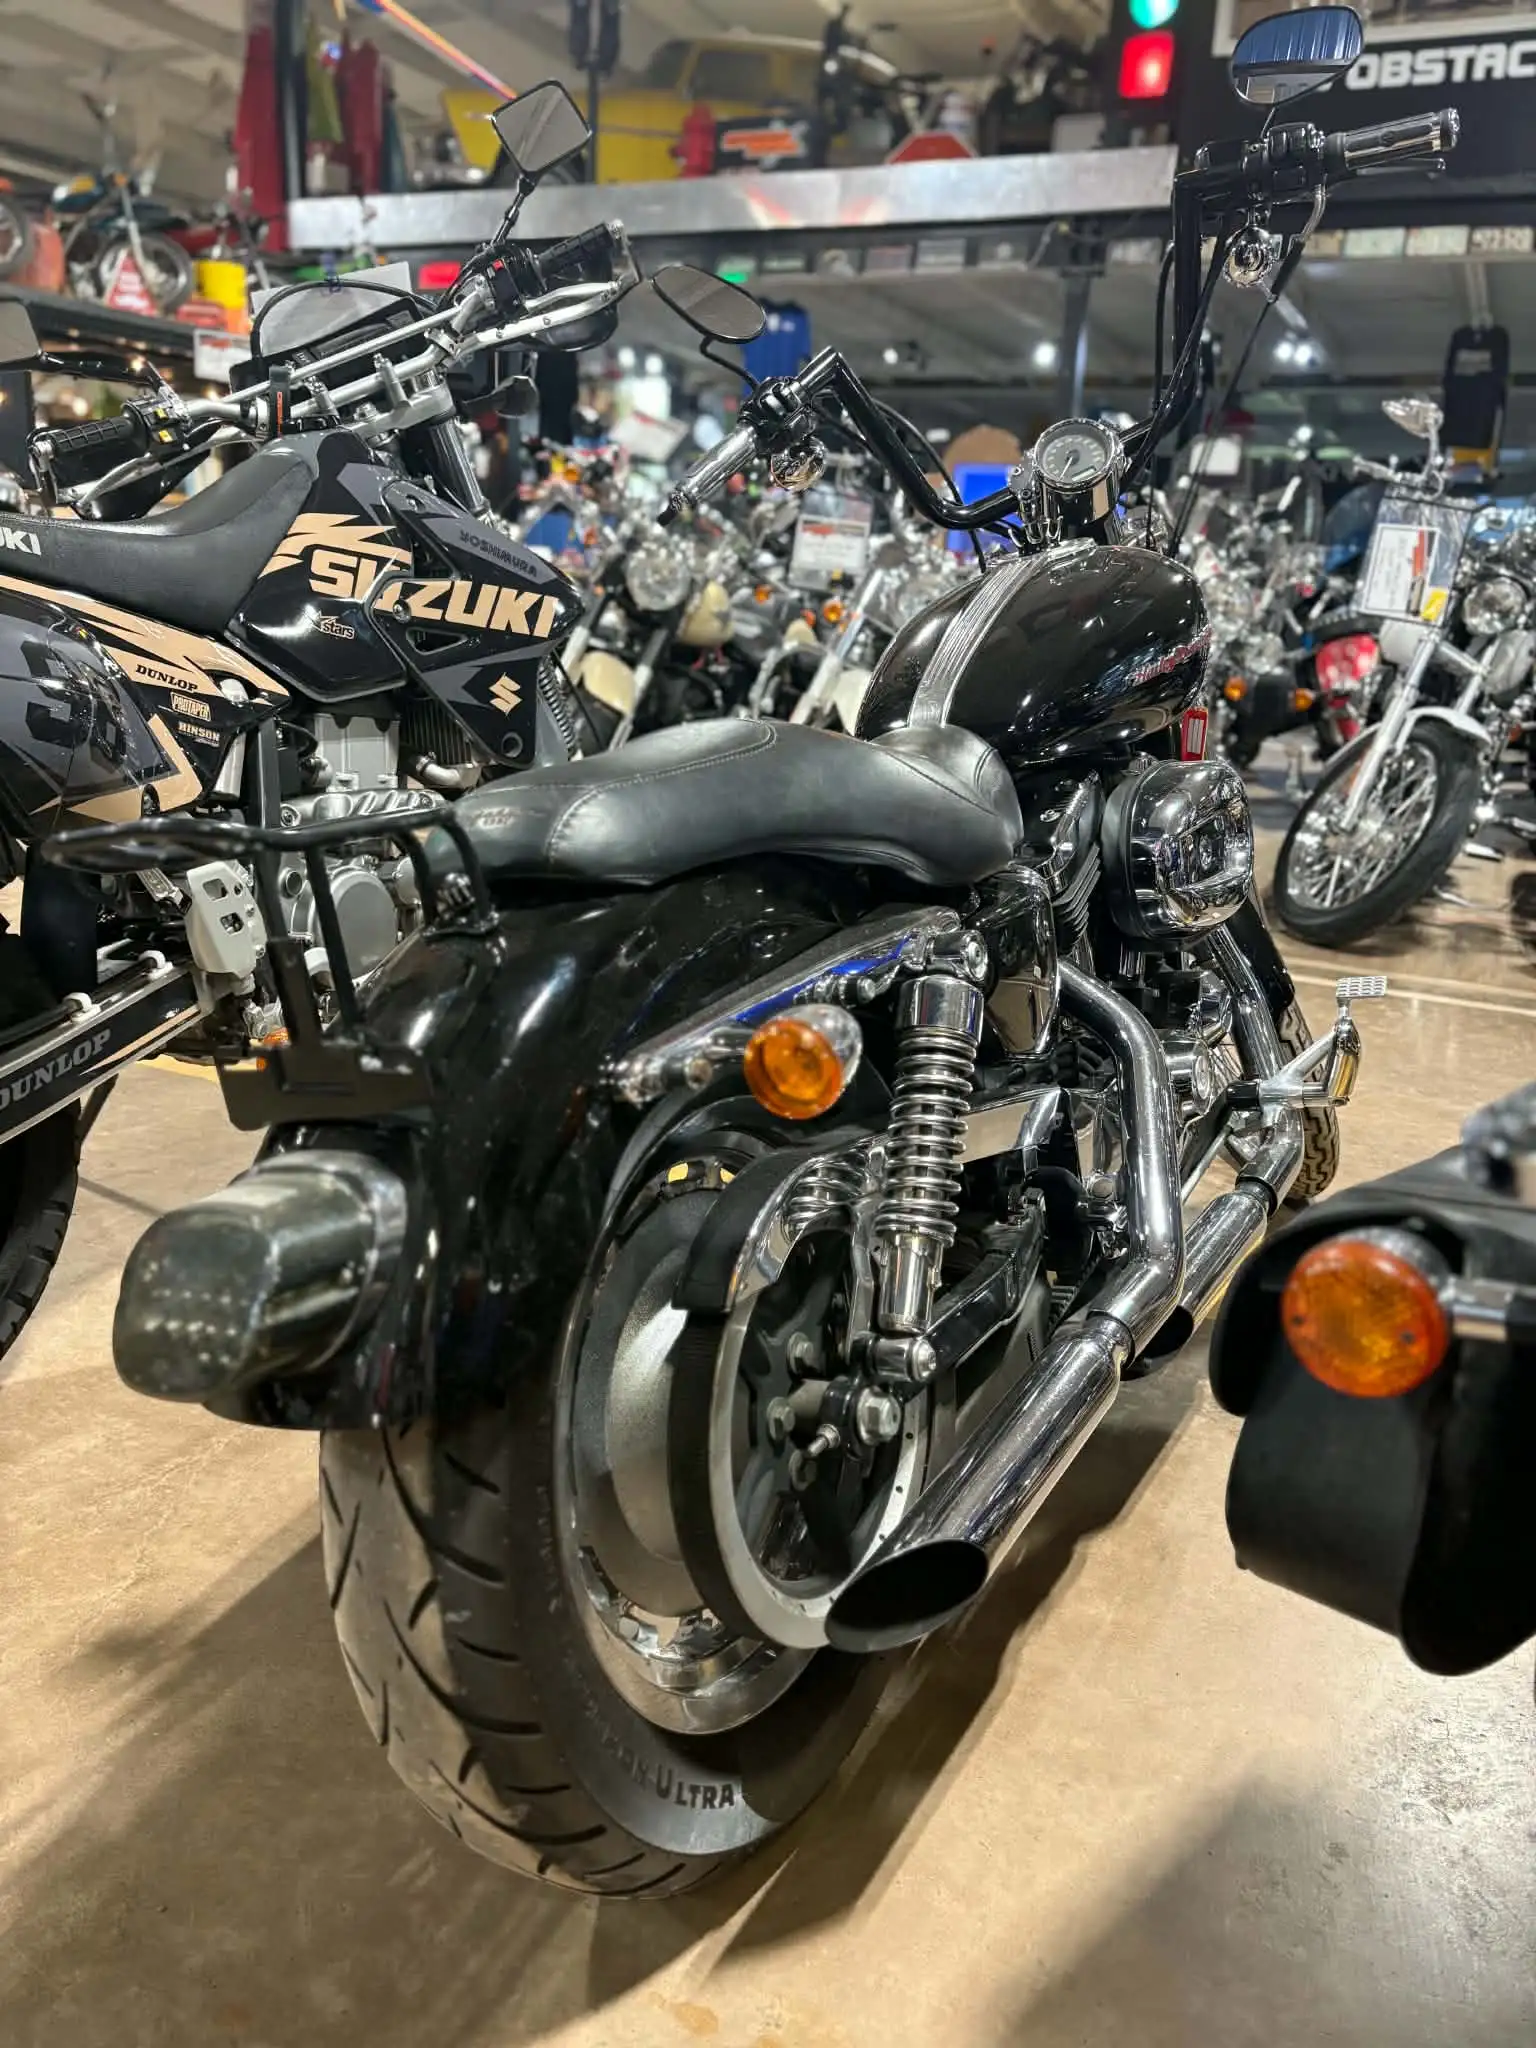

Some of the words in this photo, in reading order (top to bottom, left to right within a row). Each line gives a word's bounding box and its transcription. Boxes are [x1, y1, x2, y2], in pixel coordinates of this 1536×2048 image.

[1345, 41, 1536, 91] OBSTAC
[460, 530, 538, 578] YOSHIMURA
[309, 549, 560, 639] SUZUKI
[136, 663, 199, 691] DUNLOP
[655, 1763, 736, 1811] ULTRA
